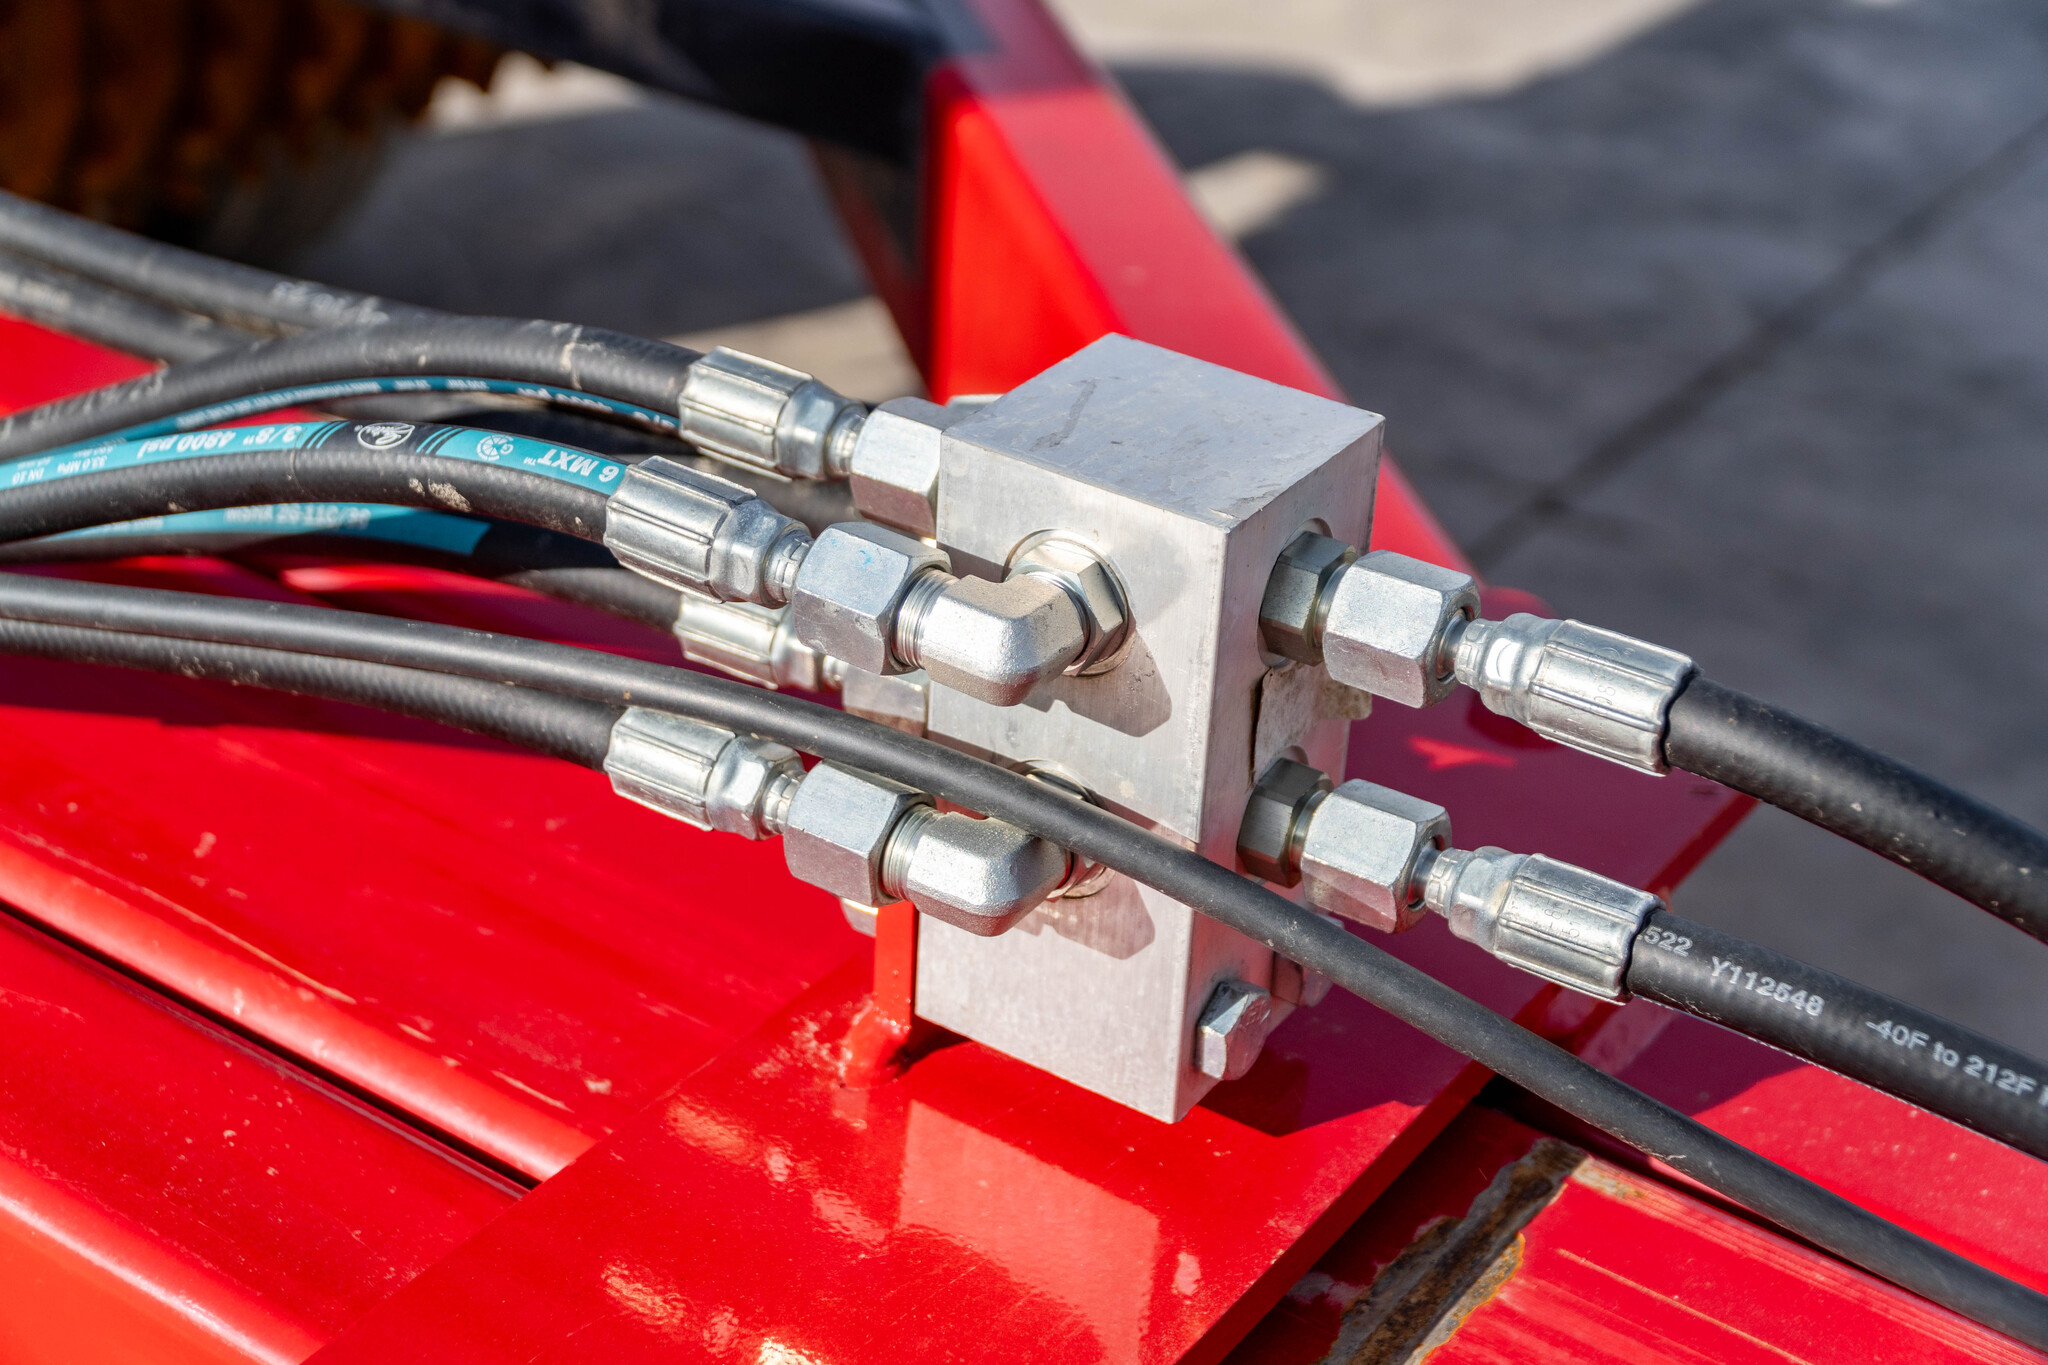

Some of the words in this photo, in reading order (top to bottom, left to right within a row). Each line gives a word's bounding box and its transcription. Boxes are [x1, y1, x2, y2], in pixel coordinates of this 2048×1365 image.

[178, 430, 236, 452] 4800
[244, 424, 302, 446] 3/8"
[136, 435, 178, 459] psi
[598, 464, 620, 483] 6
[1637, 925, 1693, 957] 522
[1711, 955, 1825, 1017] Y112548
[1866, 1019, 1929, 1050] -40F
[1933, 1041, 1960, 1068] to
[1963, 1054, 2037, 1097] 212F
